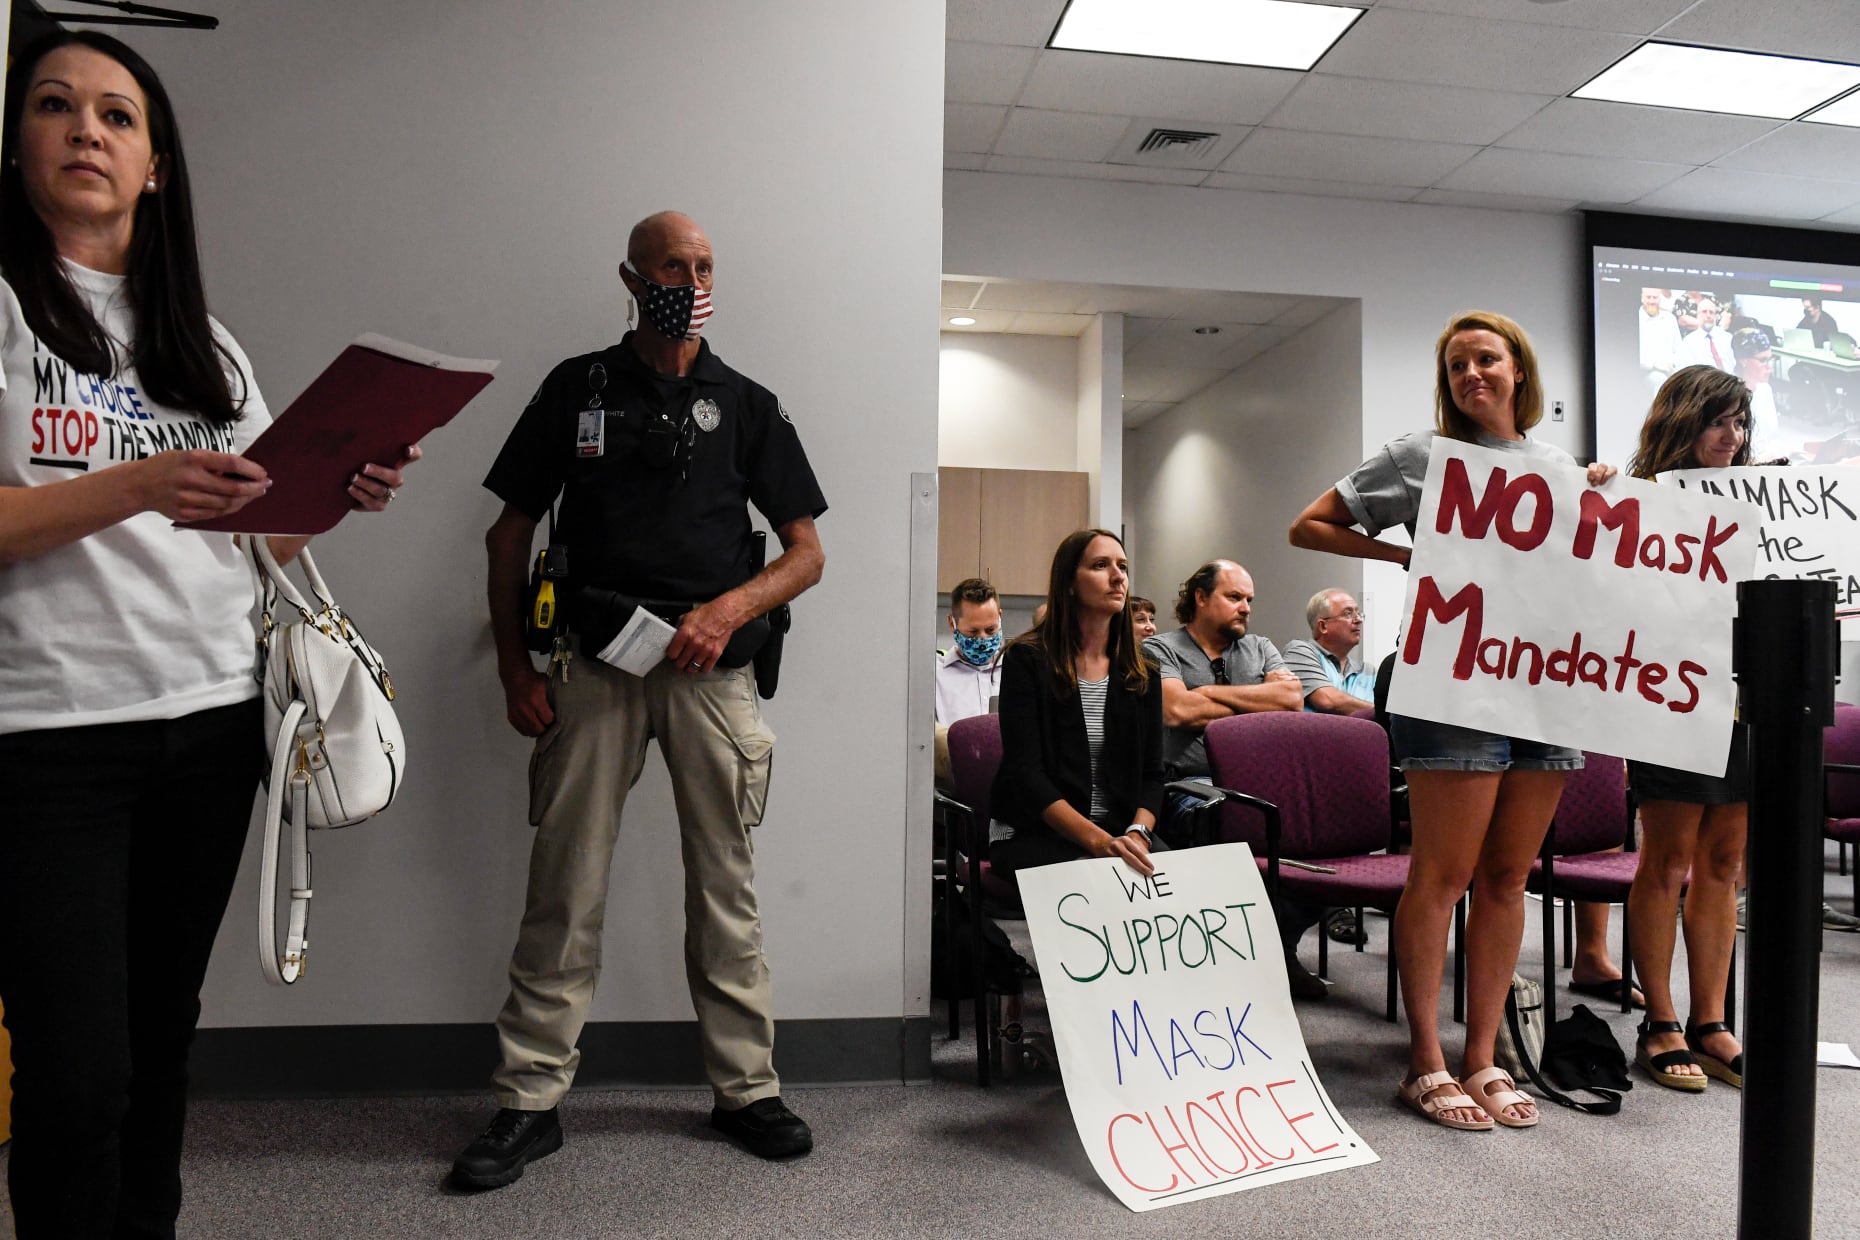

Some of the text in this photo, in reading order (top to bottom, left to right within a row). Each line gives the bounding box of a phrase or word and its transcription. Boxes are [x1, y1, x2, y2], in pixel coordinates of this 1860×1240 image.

[33, 356, 66, 405] MY
[32, 407, 98, 457] STOP
[103, 416, 149, 461] THE
[1435, 457, 1553, 551] NO
[1679, 475, 1858, 522] MASK
[1758, 526, 1824, 562] he
[1403, 575, 1707, 713] Mandates
[1112, 866, 1173, 902] WE
[1057, 892, 1256, 983] SUPPORT
[1112, 999, 1272, 1085] MASK
